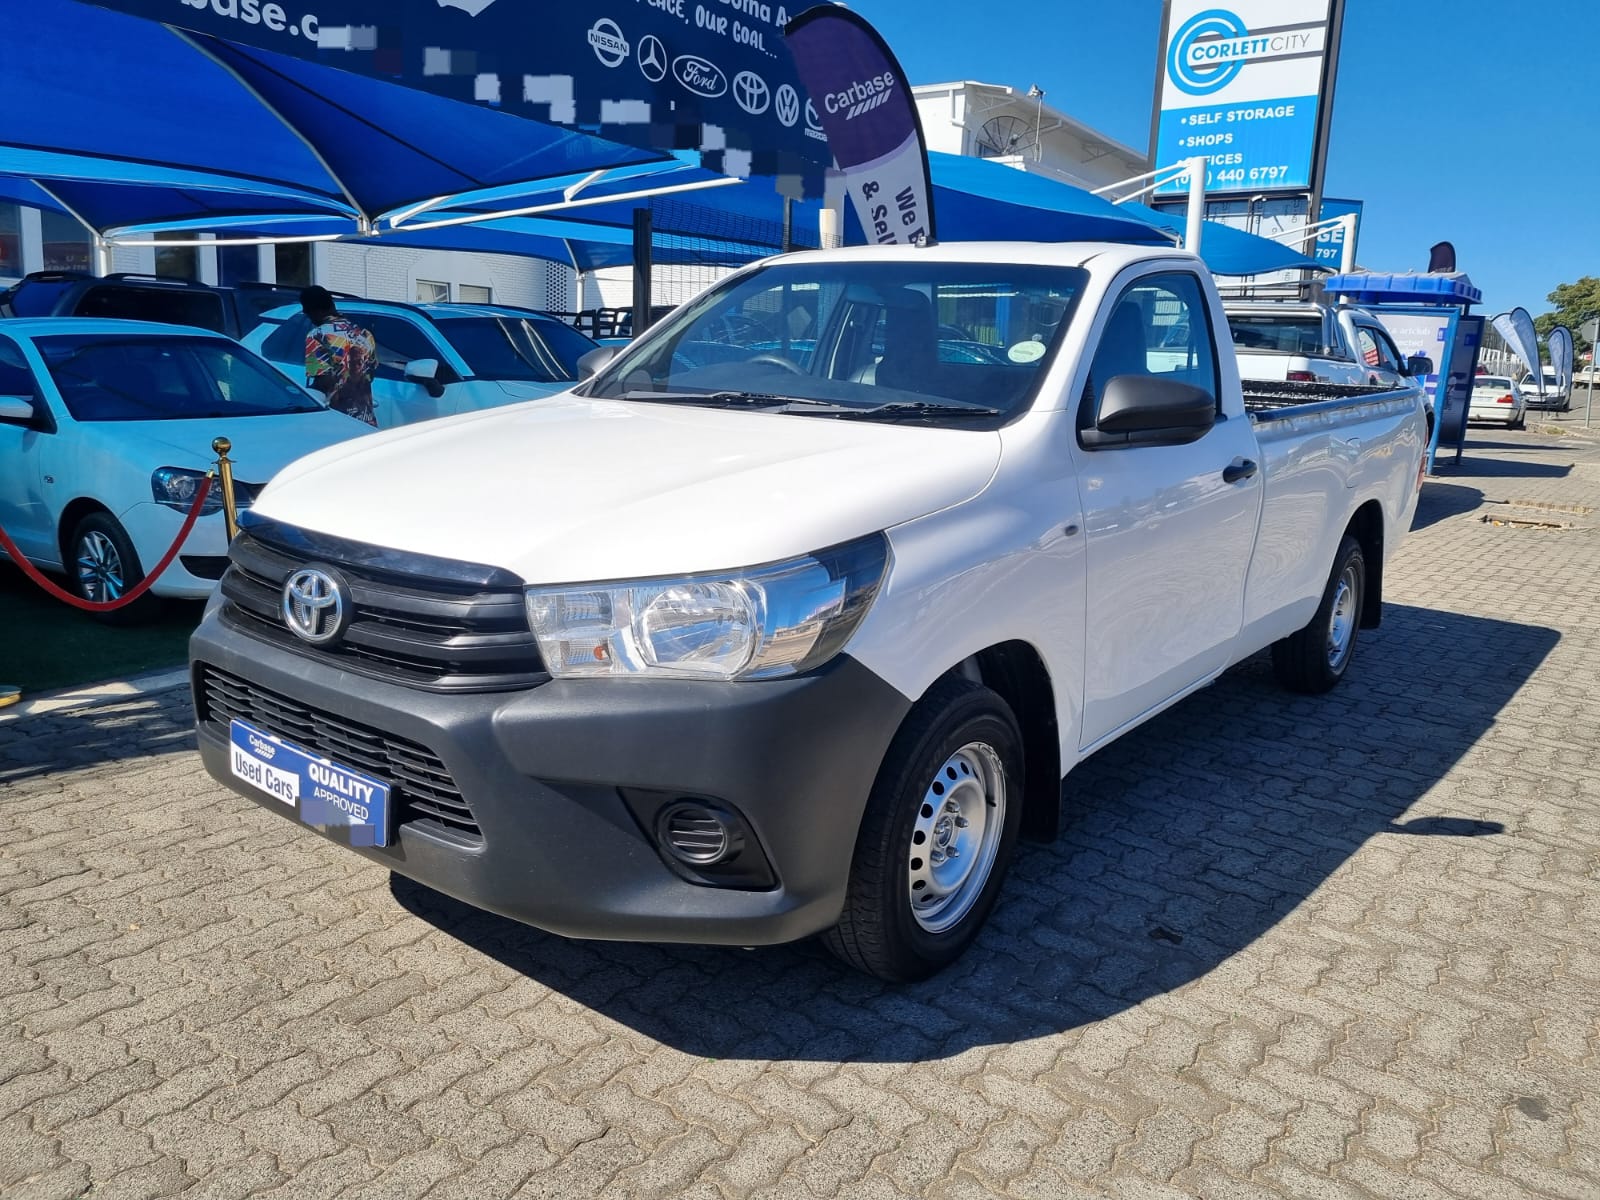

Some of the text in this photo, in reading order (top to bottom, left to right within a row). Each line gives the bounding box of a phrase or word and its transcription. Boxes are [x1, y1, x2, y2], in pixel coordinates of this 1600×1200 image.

[635, 0, 690, 25] ACE,
[695, 4, 728, 37] OUR
[590, 32, 628, 53] NISSAN
[682, 60, 719, 91] Ford
[824, 71, 895, 114] Carbase
[1188, 105, 1296, 126] SELF STORAGE
[1186, 133, 1233, 148] SHOPS
[1187, 153, 1243, 167] ICES
[1216, 168, 1245, 182] 440
[1250, 165, 1289, 180] 6797
[862, 180, 880, 202] &
[895, 185, 917, 226] We
[1315, 248, 1338, 259] 797
[249, 734, 276, 755] Carbase
[235, 751, 294, 801] Used Cars
[308, 763, 374, 804] QUALITY
[313, 787, 369, 820] APPROVED
